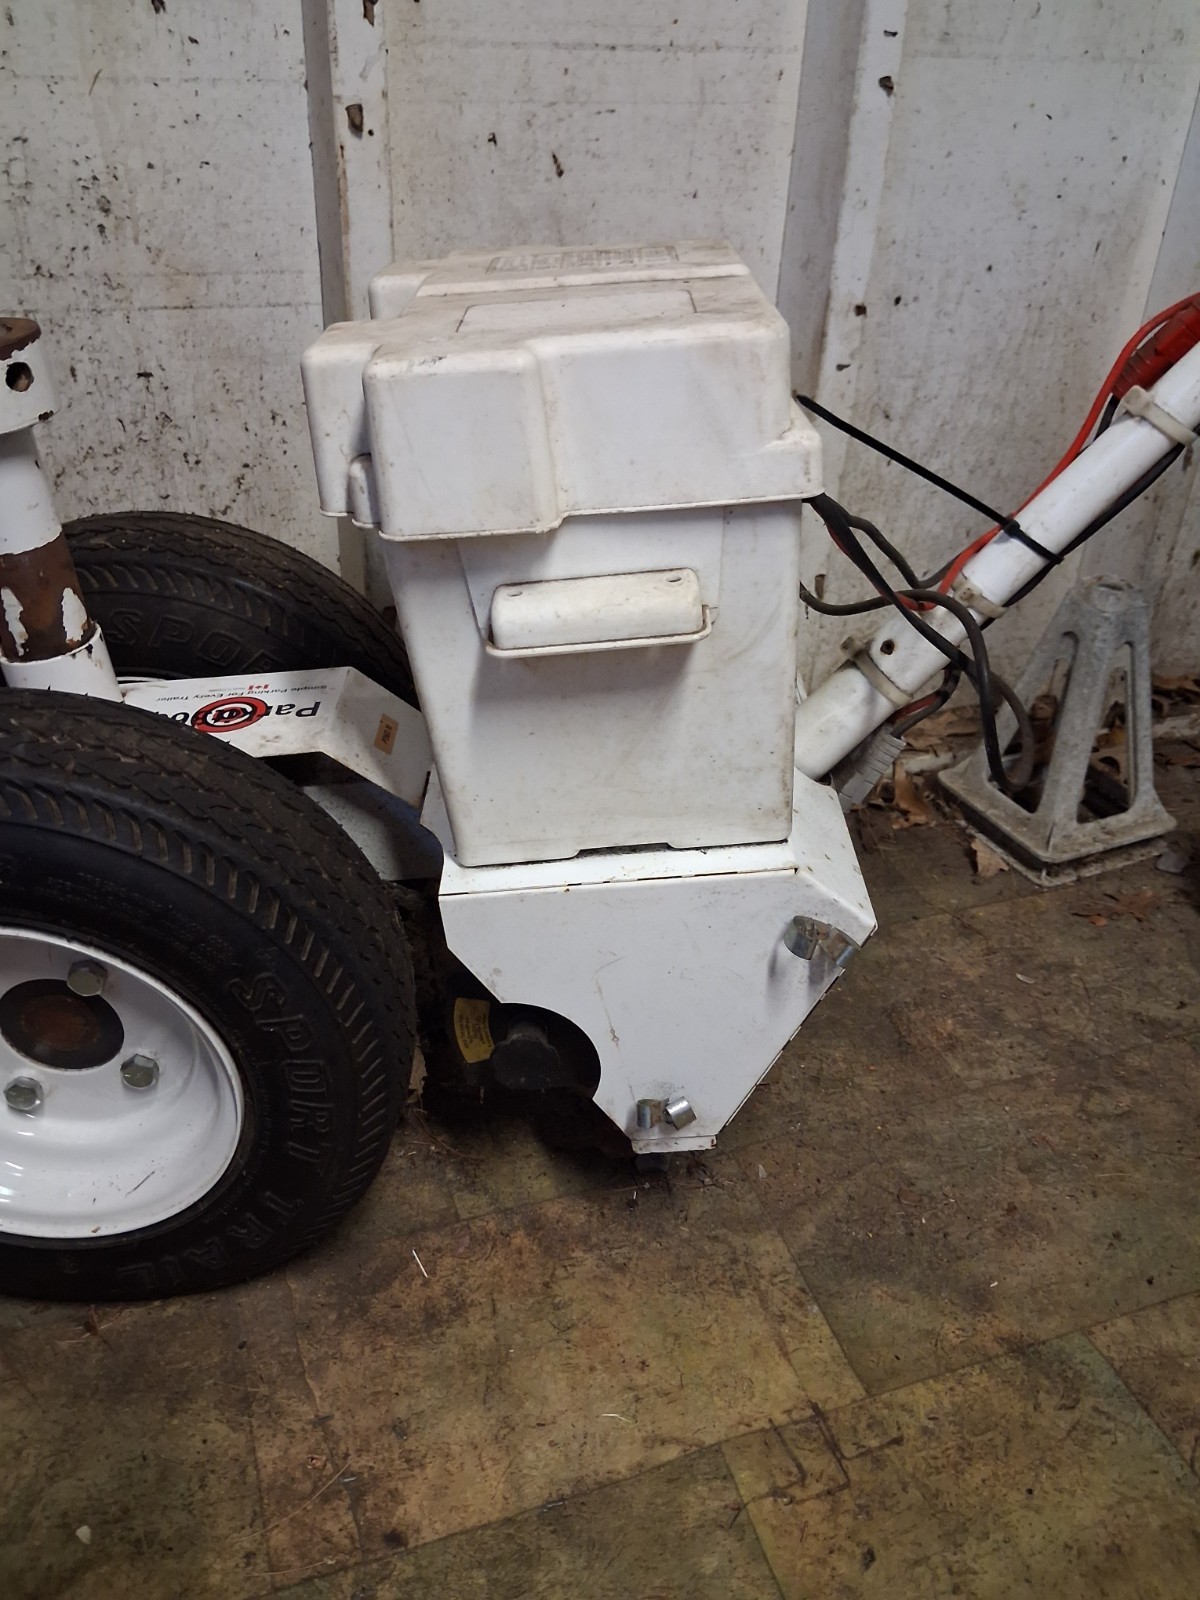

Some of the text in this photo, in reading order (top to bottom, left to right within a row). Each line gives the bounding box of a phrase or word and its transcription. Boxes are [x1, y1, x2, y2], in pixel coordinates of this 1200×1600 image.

[247, 688, 288, 696] Parking
[290, 685, 327, 693] Simple
[227, 971, 334, 1176] SPORT
